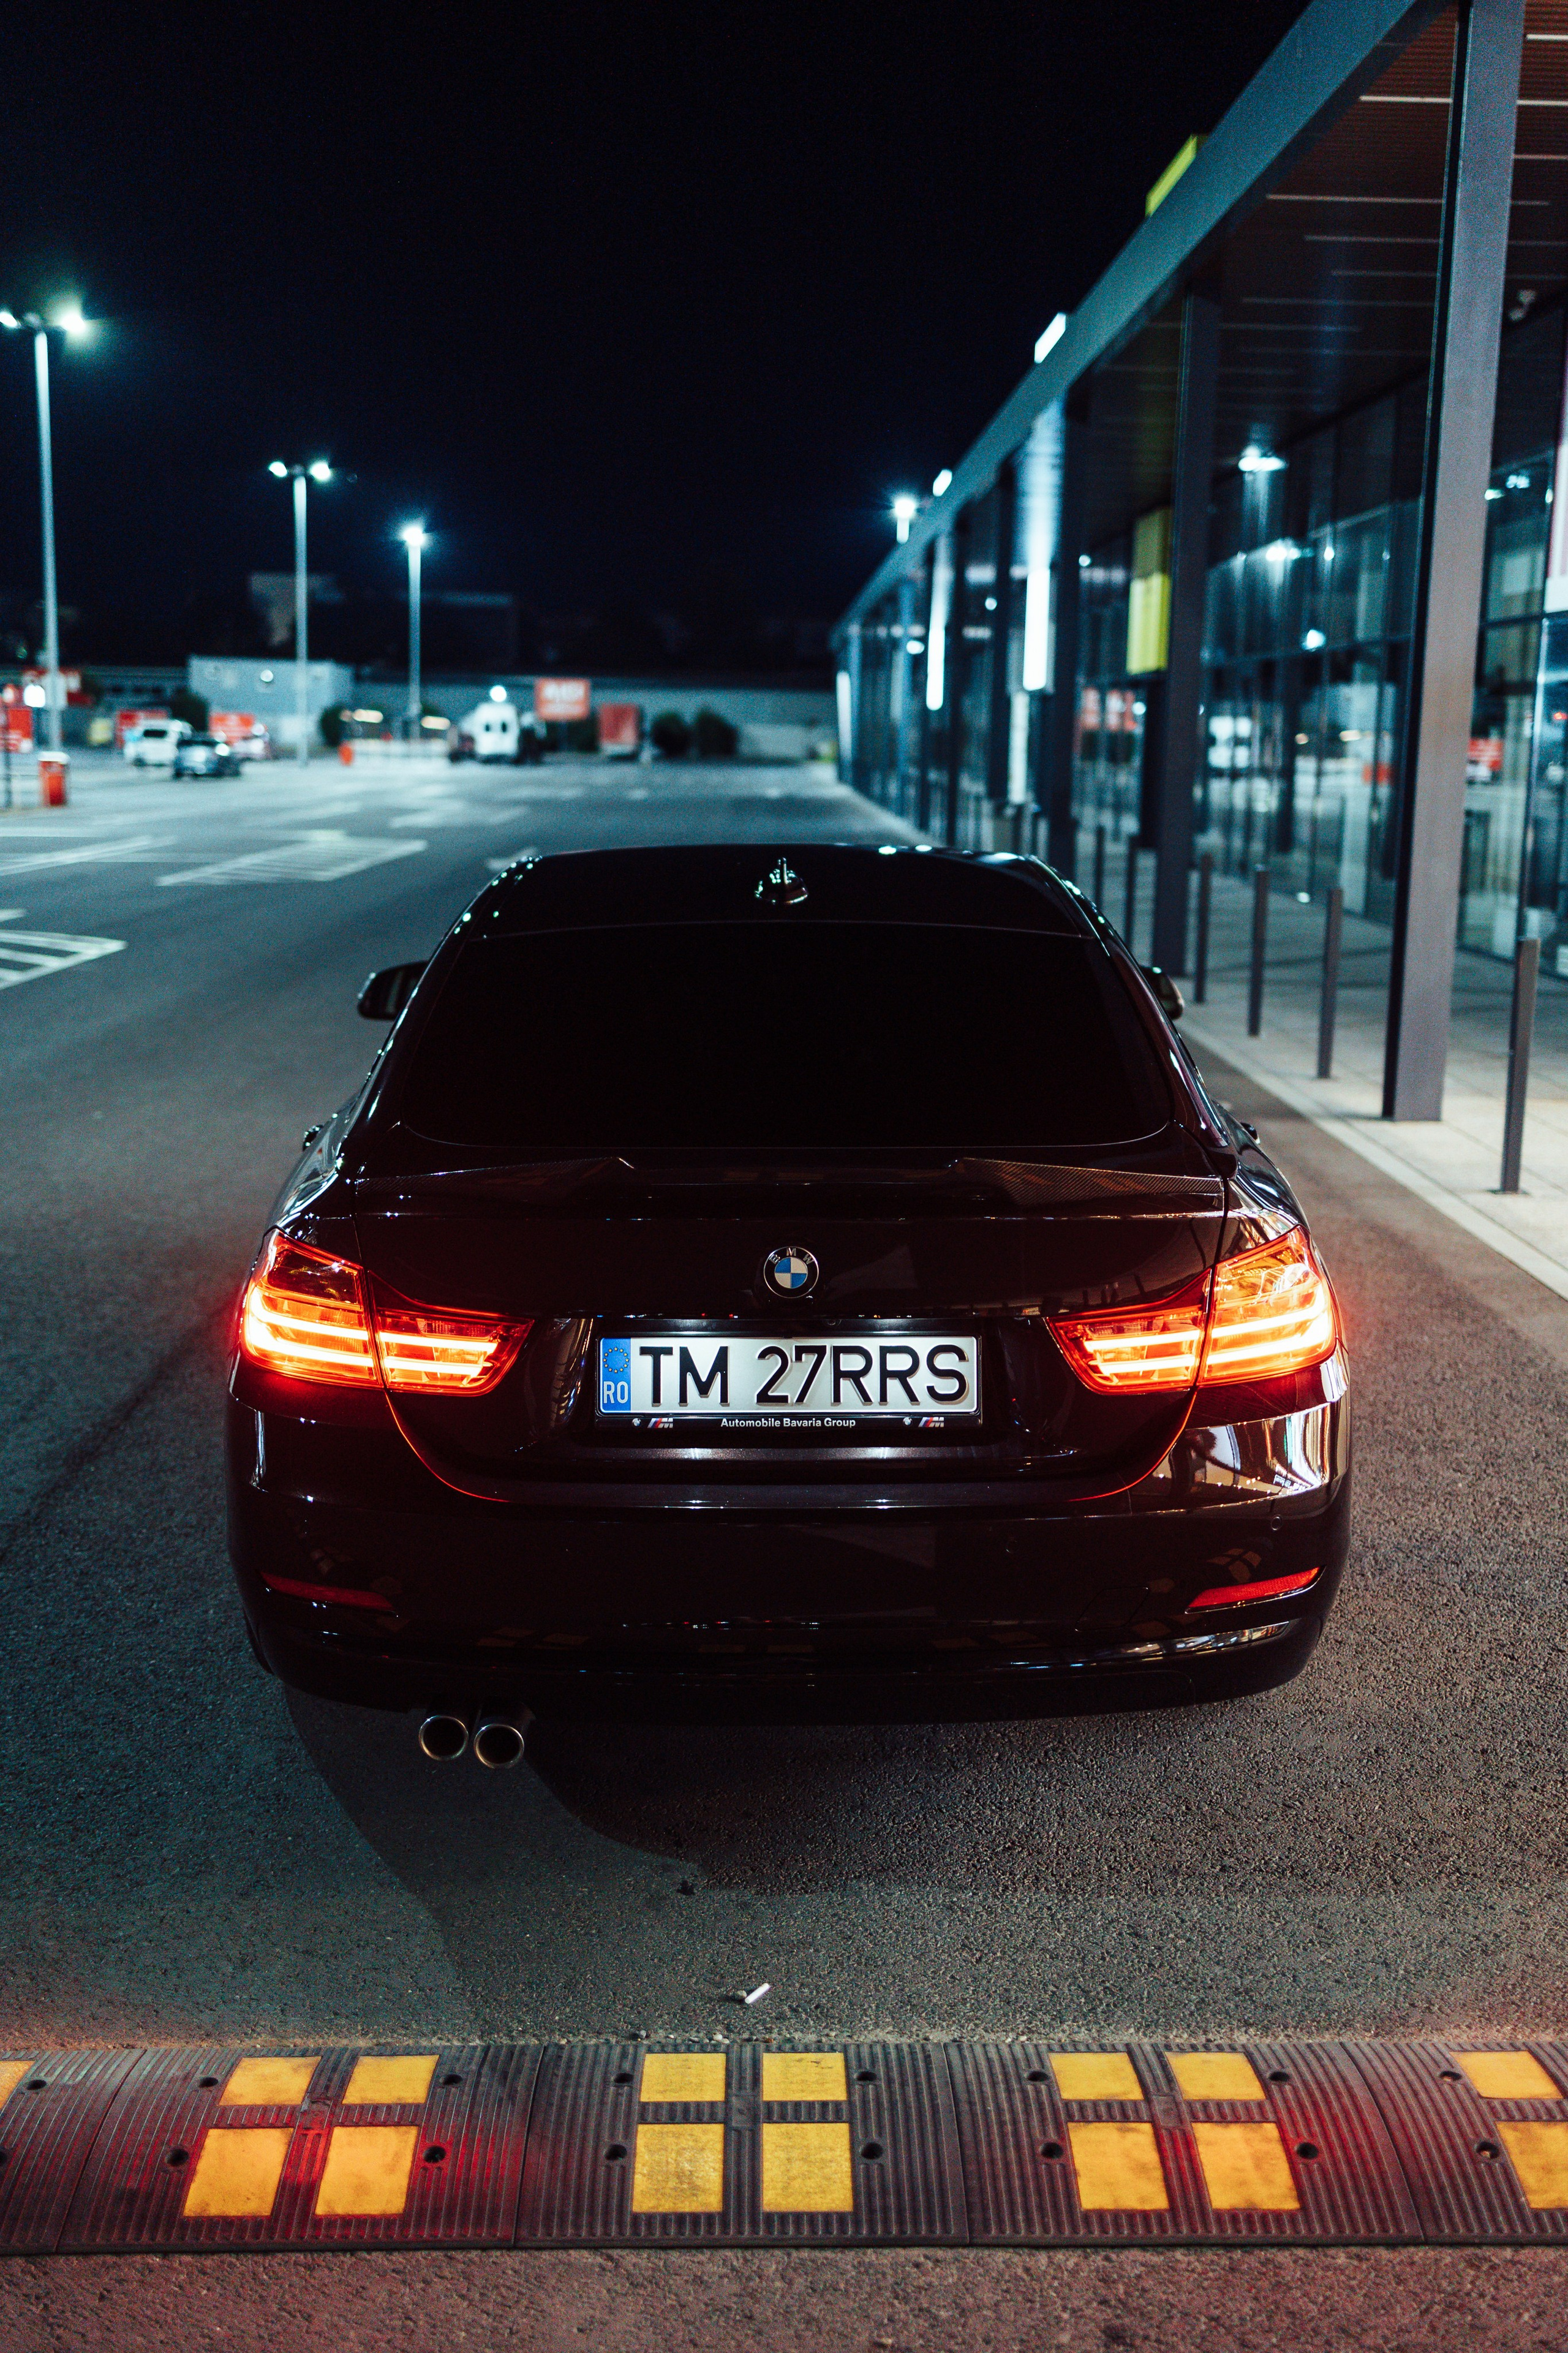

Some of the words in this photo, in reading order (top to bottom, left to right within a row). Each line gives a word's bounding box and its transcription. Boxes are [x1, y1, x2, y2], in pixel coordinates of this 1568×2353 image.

[769, 1247, 815, 1265] BMW
[639, 1346, 729, 1406] TM
[756, 1344, 968, 1405] 27RRS
[603, 1381, 629, 1404] RO
[720, 1418, 781, 1427] Automobile
[783, 1418, 821, 1427] Bavaria
[824, 1418, 856, 1428] Group
